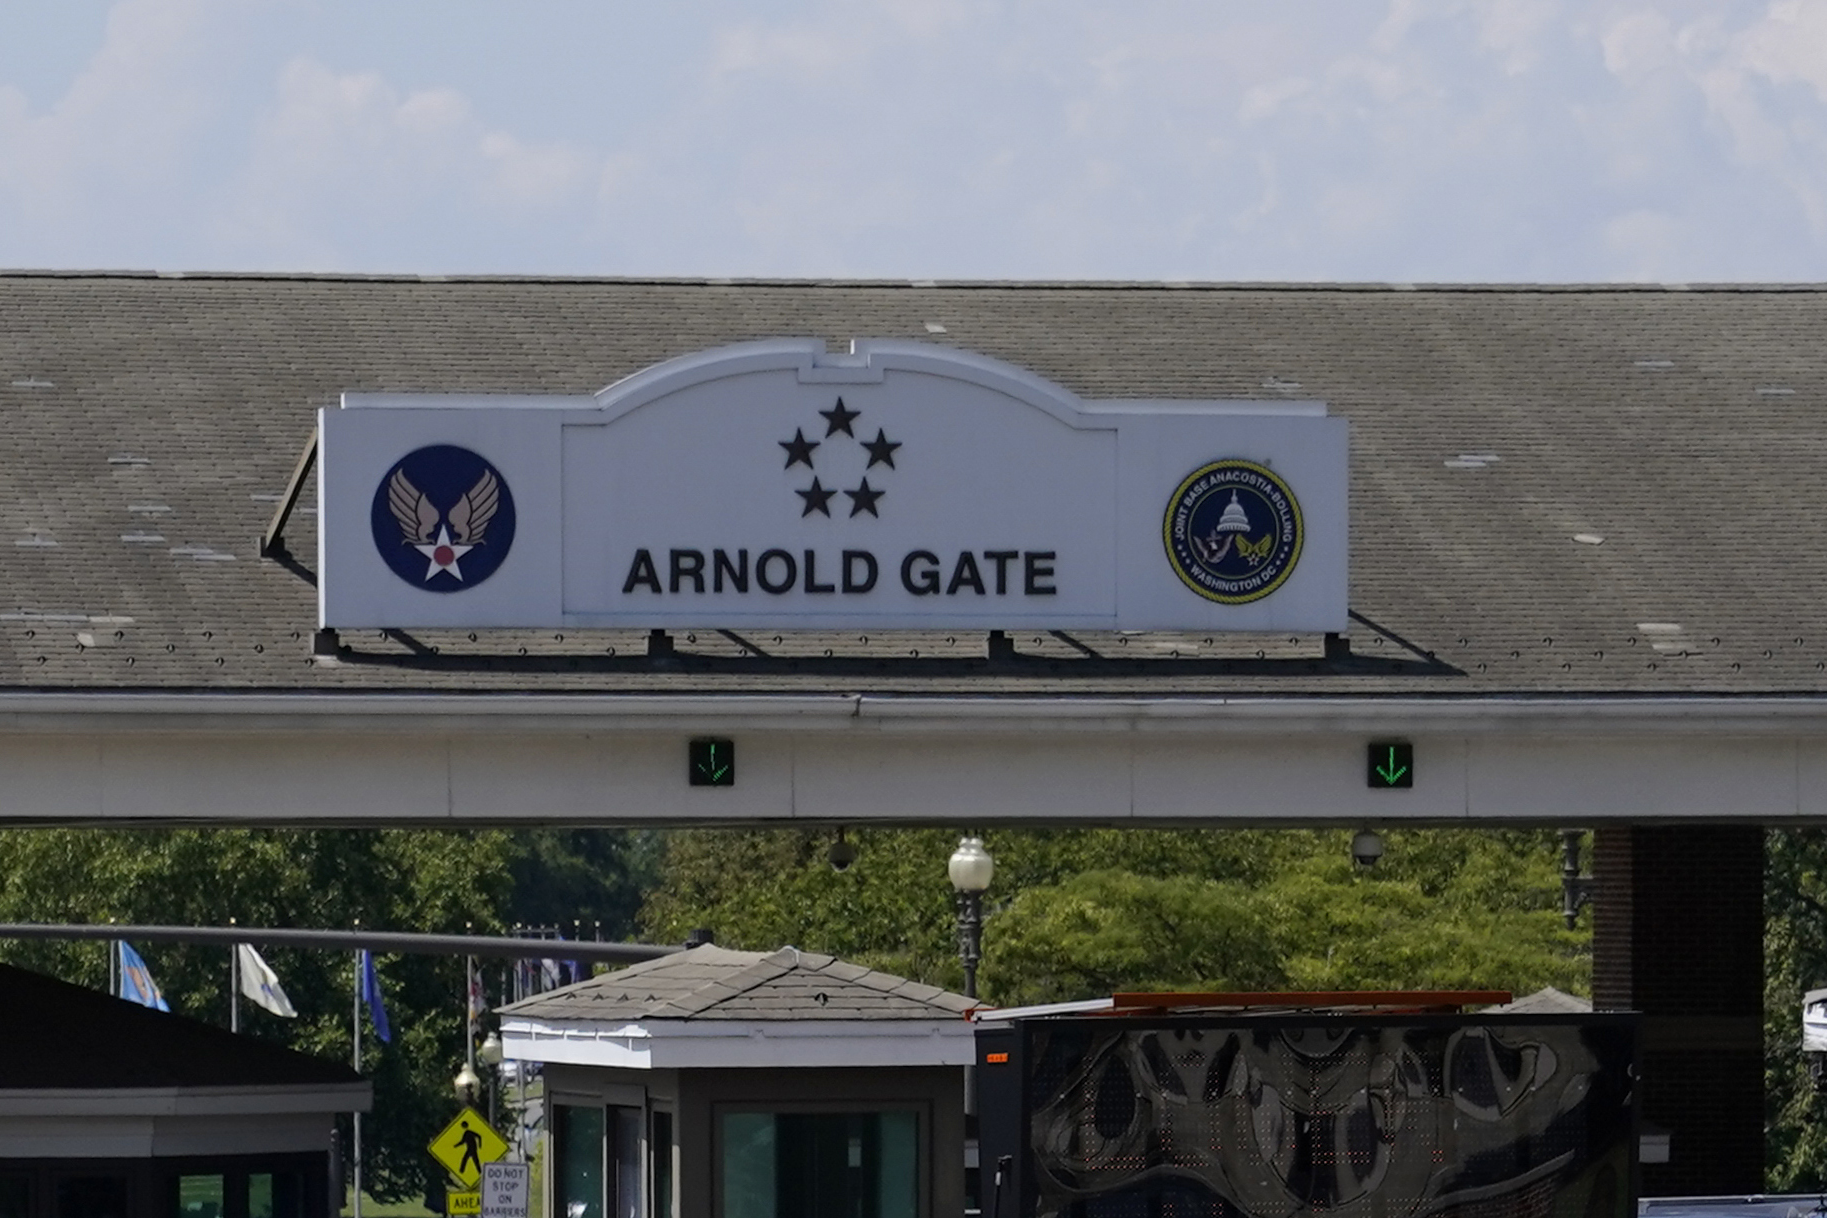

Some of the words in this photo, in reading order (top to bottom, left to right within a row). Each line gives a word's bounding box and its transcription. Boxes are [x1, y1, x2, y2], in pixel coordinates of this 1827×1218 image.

[1175, 505, 1189, 541] JOINT
[1183, 480, 1210, 507] BASE
[1209, 470, 1293, 543] ANACOSTIA-BOLLING
[622, 548, 879, 595] ARNOLD
[900, 550, 1058, 596] GATE
[1190, 564, 1261, 593] WASHINGTON
[1260, 565, 1277, 581] DC
[487, 1168, 502, 1179] DO
[504, 1168, 524, 1179] NOT
[492, 1181, 519, 1192] STOP
[454, 1197, 481, 1209] AHEA
[498, 1194, 512, 1204] ON
